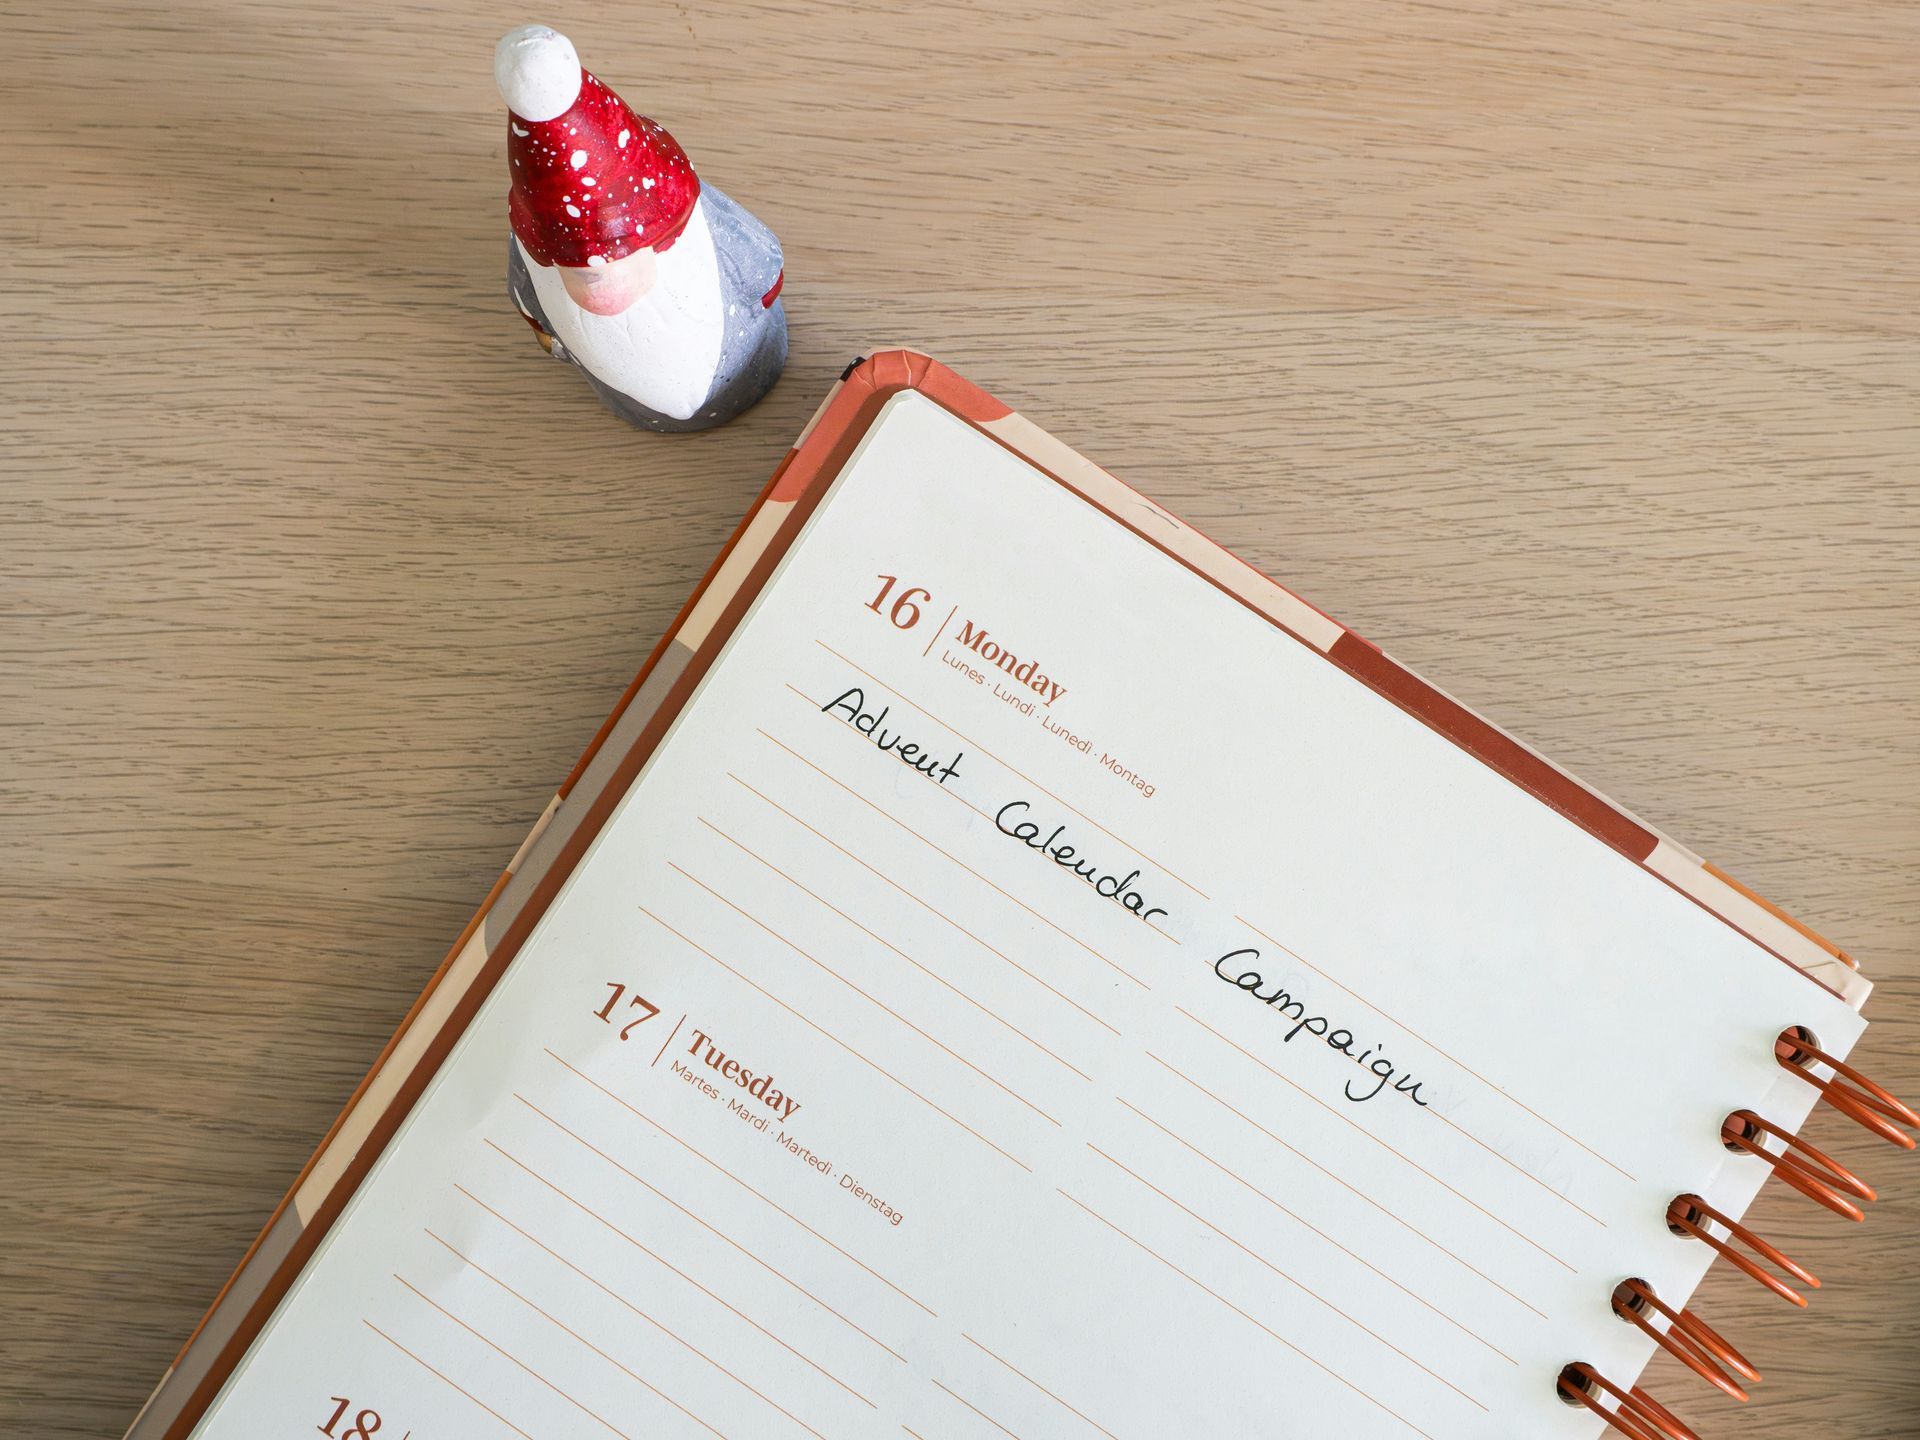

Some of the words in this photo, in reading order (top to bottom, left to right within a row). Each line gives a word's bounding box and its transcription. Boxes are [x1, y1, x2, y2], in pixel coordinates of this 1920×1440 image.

[864, 575, 931, 629] 16
[954, 620, 1068, 708] Monday
[942, 649, 985, 685] Lunes
[993, 683, 1036, 718] Lundi
[1099, 753, 1156, 798] Montag
[821, 688, 963, 784] Advent
[995, 801, 1168, 921] Calendar
[1214, 949, 1427, 1106] Campaign
[593, 982, 660, 1041] 17
[687, 1029, 801, 1123] Tuesday
[671, 1060, 720, 1100] Martes
[727, 1098, 769, 1133] Mardi
[839, 1174, 904, 1226] Dienstag
[317, 1396, 382, 1440] 18
